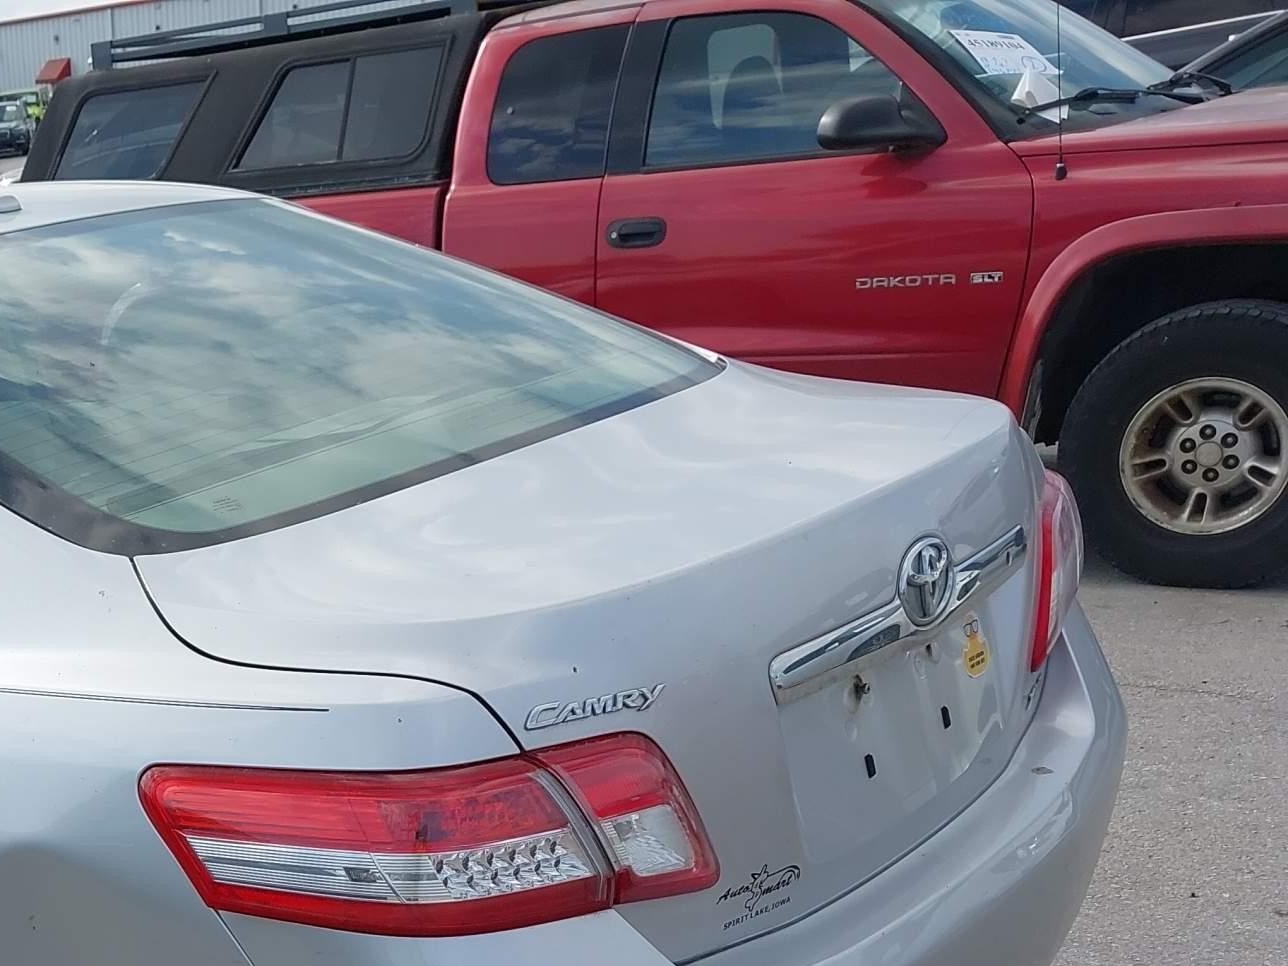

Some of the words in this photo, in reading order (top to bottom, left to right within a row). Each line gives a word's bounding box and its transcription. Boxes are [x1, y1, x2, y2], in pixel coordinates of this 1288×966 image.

[855, 274, 956, 289] DAKOTA
[971, 272, 1003, 283] SLT
[524, 683, 666, 731] CAMRY
[723, 914, 749, 931] SPIRIT
[770, 896, 791, 911] IOWA
